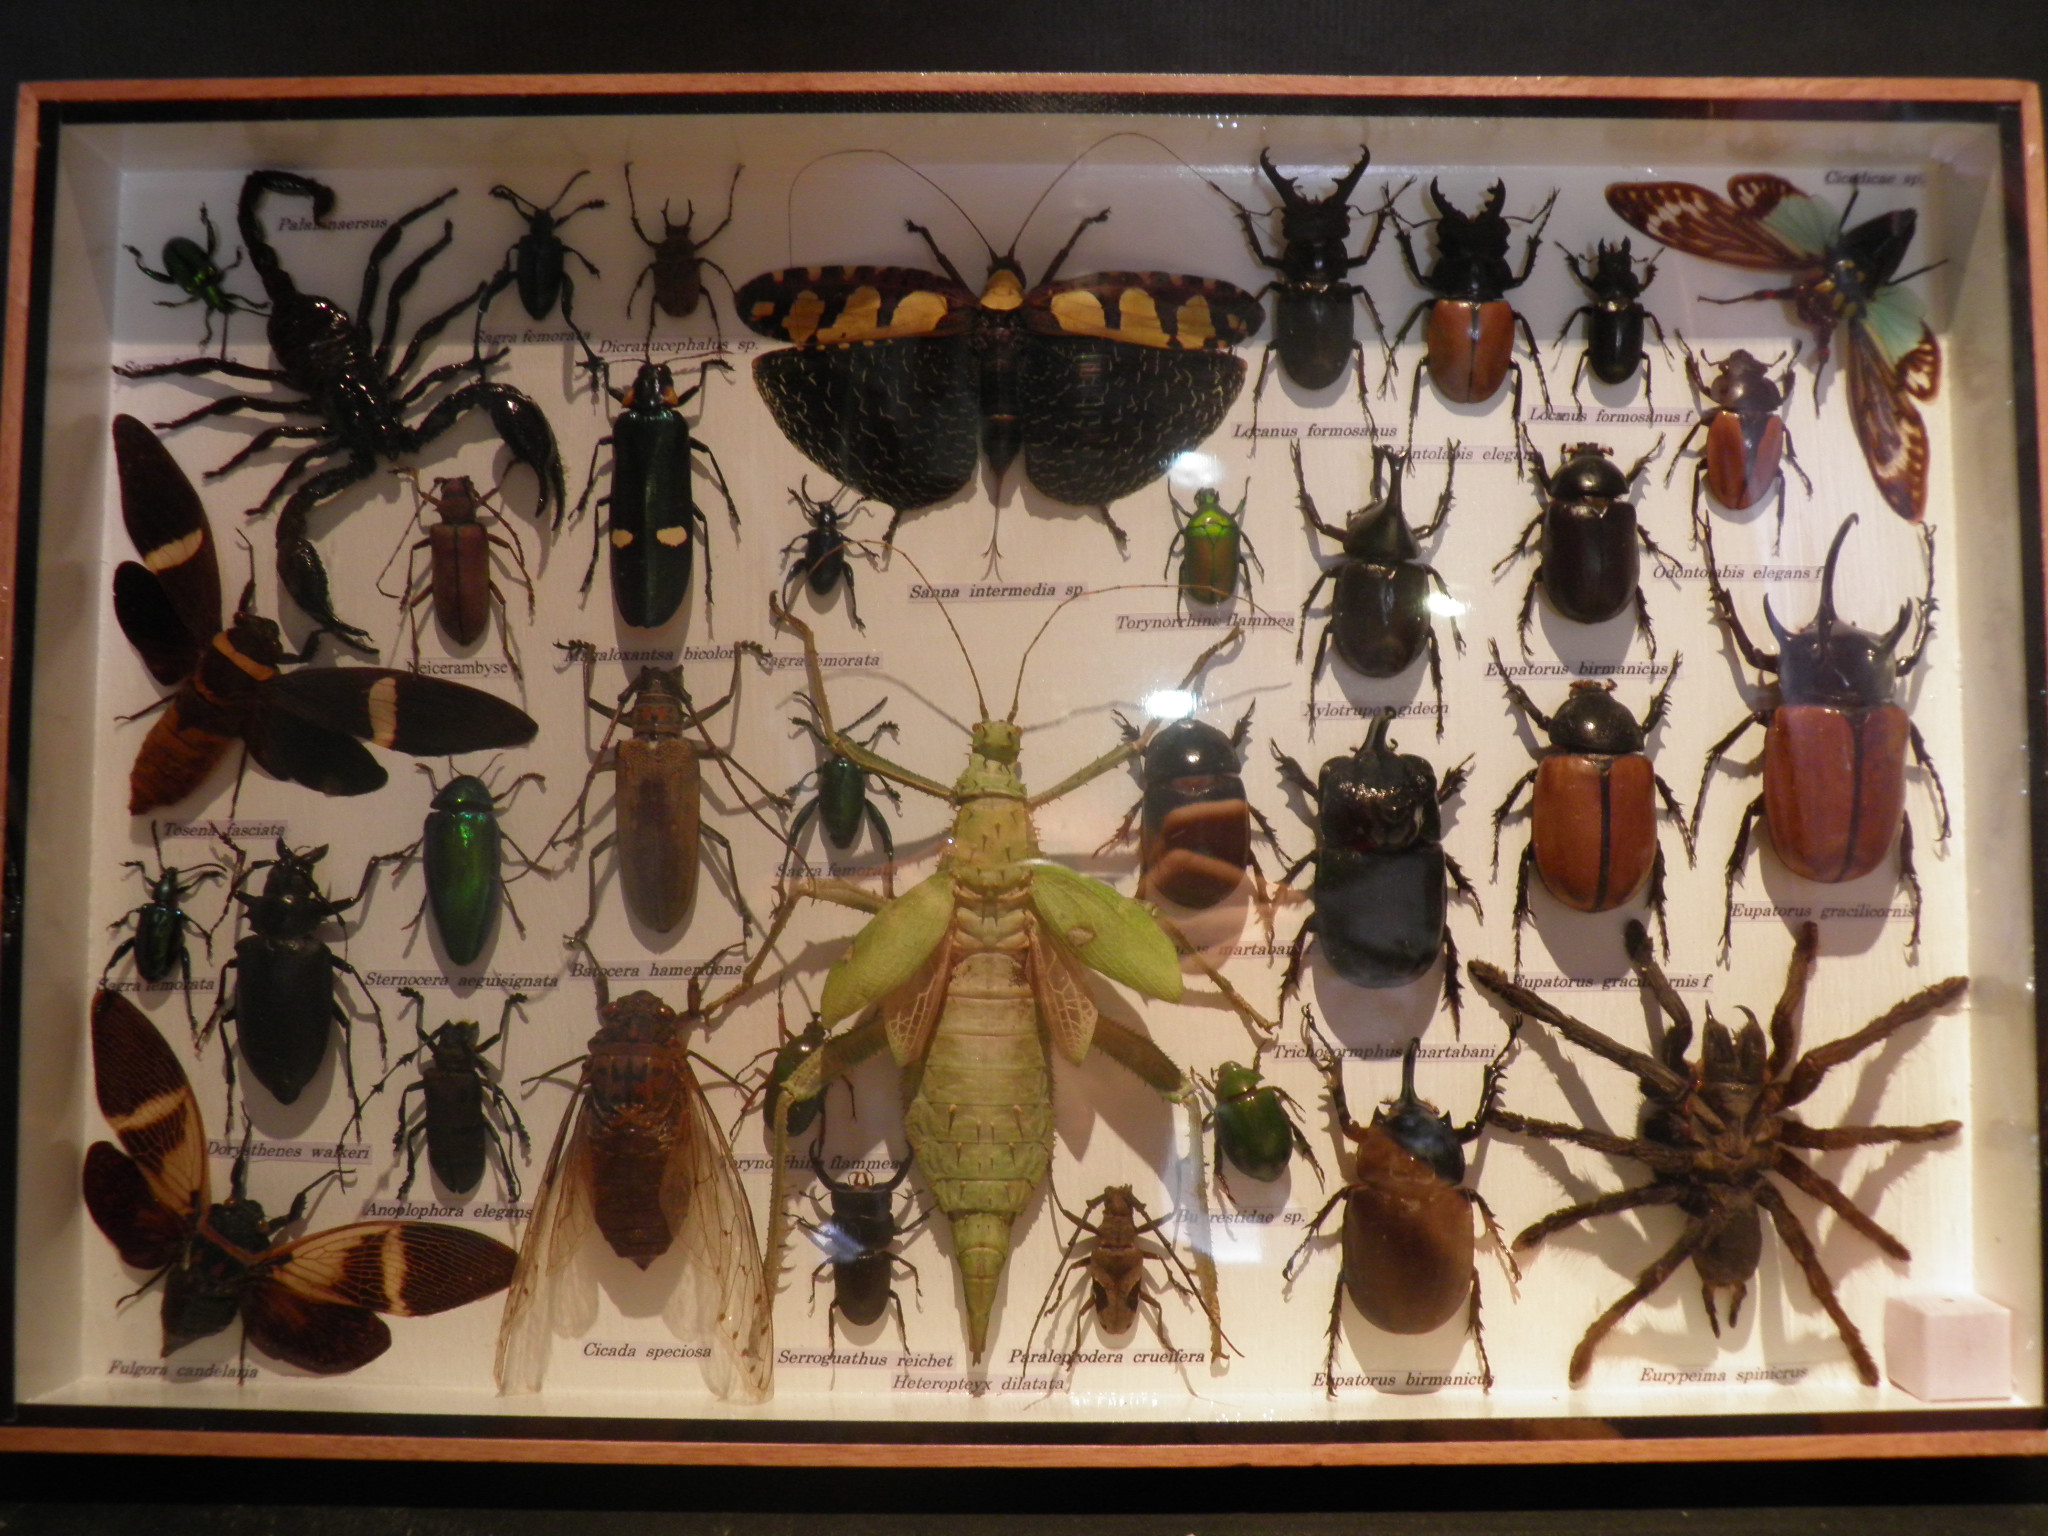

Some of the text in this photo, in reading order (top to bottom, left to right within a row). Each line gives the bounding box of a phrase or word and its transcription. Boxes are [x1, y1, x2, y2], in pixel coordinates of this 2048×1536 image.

[1824, 171, 1896, 185] Cicdicae
[278, 217, 389, 232] Palanaersus
[523, 329, 591, 344] femoraa
[738, 341, 759, 355] sp.
[1596, 408, 1681, 423] formosanus
[1685, 410, 1693, 423] f
[1384, 447, 1540, 462] dntolais elegan
[1654, 564, 1822, 581] Odontoabis elegans f
[910, 585, 960, 599] Sanna
[969, 584, 1056, 598] intermedia
[1226, 613, 1295, 628] flammea
[565, 646, 737, 664] Maloxantsa bicolor
[760, 654, 880, 670] Sagra emorata
[1579, 660, 1669, 675] birmanicus
[1304, 702, 1449, 719] Xylotrupe gideon
[226, 822, 286, 837] fasciata
[827, 864, 898, 878] femoraa
[1731, 902, 1915, 920] Eupatorus gracilicornis
[650, 962, 742, 976] hamerdens
[365, 971, 449, 987] Sternocera
[1513, 973, 1712, 990] Eupatorus gracilrnis f
[1416, 1043, 1496, 1059] martabani
[311, 1143, 371, 1158] walkeri
[722, 1155, 901, 1171] orynohin flammea
[365, 1202, 533, 1219] Anoplophora elegans
[1175, 1209, 1305, 1224] Burestidae sp.
[583, 1343, 712, 1360] Cicada speciosa
[777, 1350, 953, 1367] Serroguathus reichet
[1008, 1349, 1123, 1366] Paralepodera
[108, 1361, 258, 1378] Fulgora candelaia
[1640, 1364, 1808, 1384] Eurypeima spinicrus
[892, 1374, 1064, 1392] Heteropteyx dilatata
[1313, 1372, 1395, 1388] Epatorus
